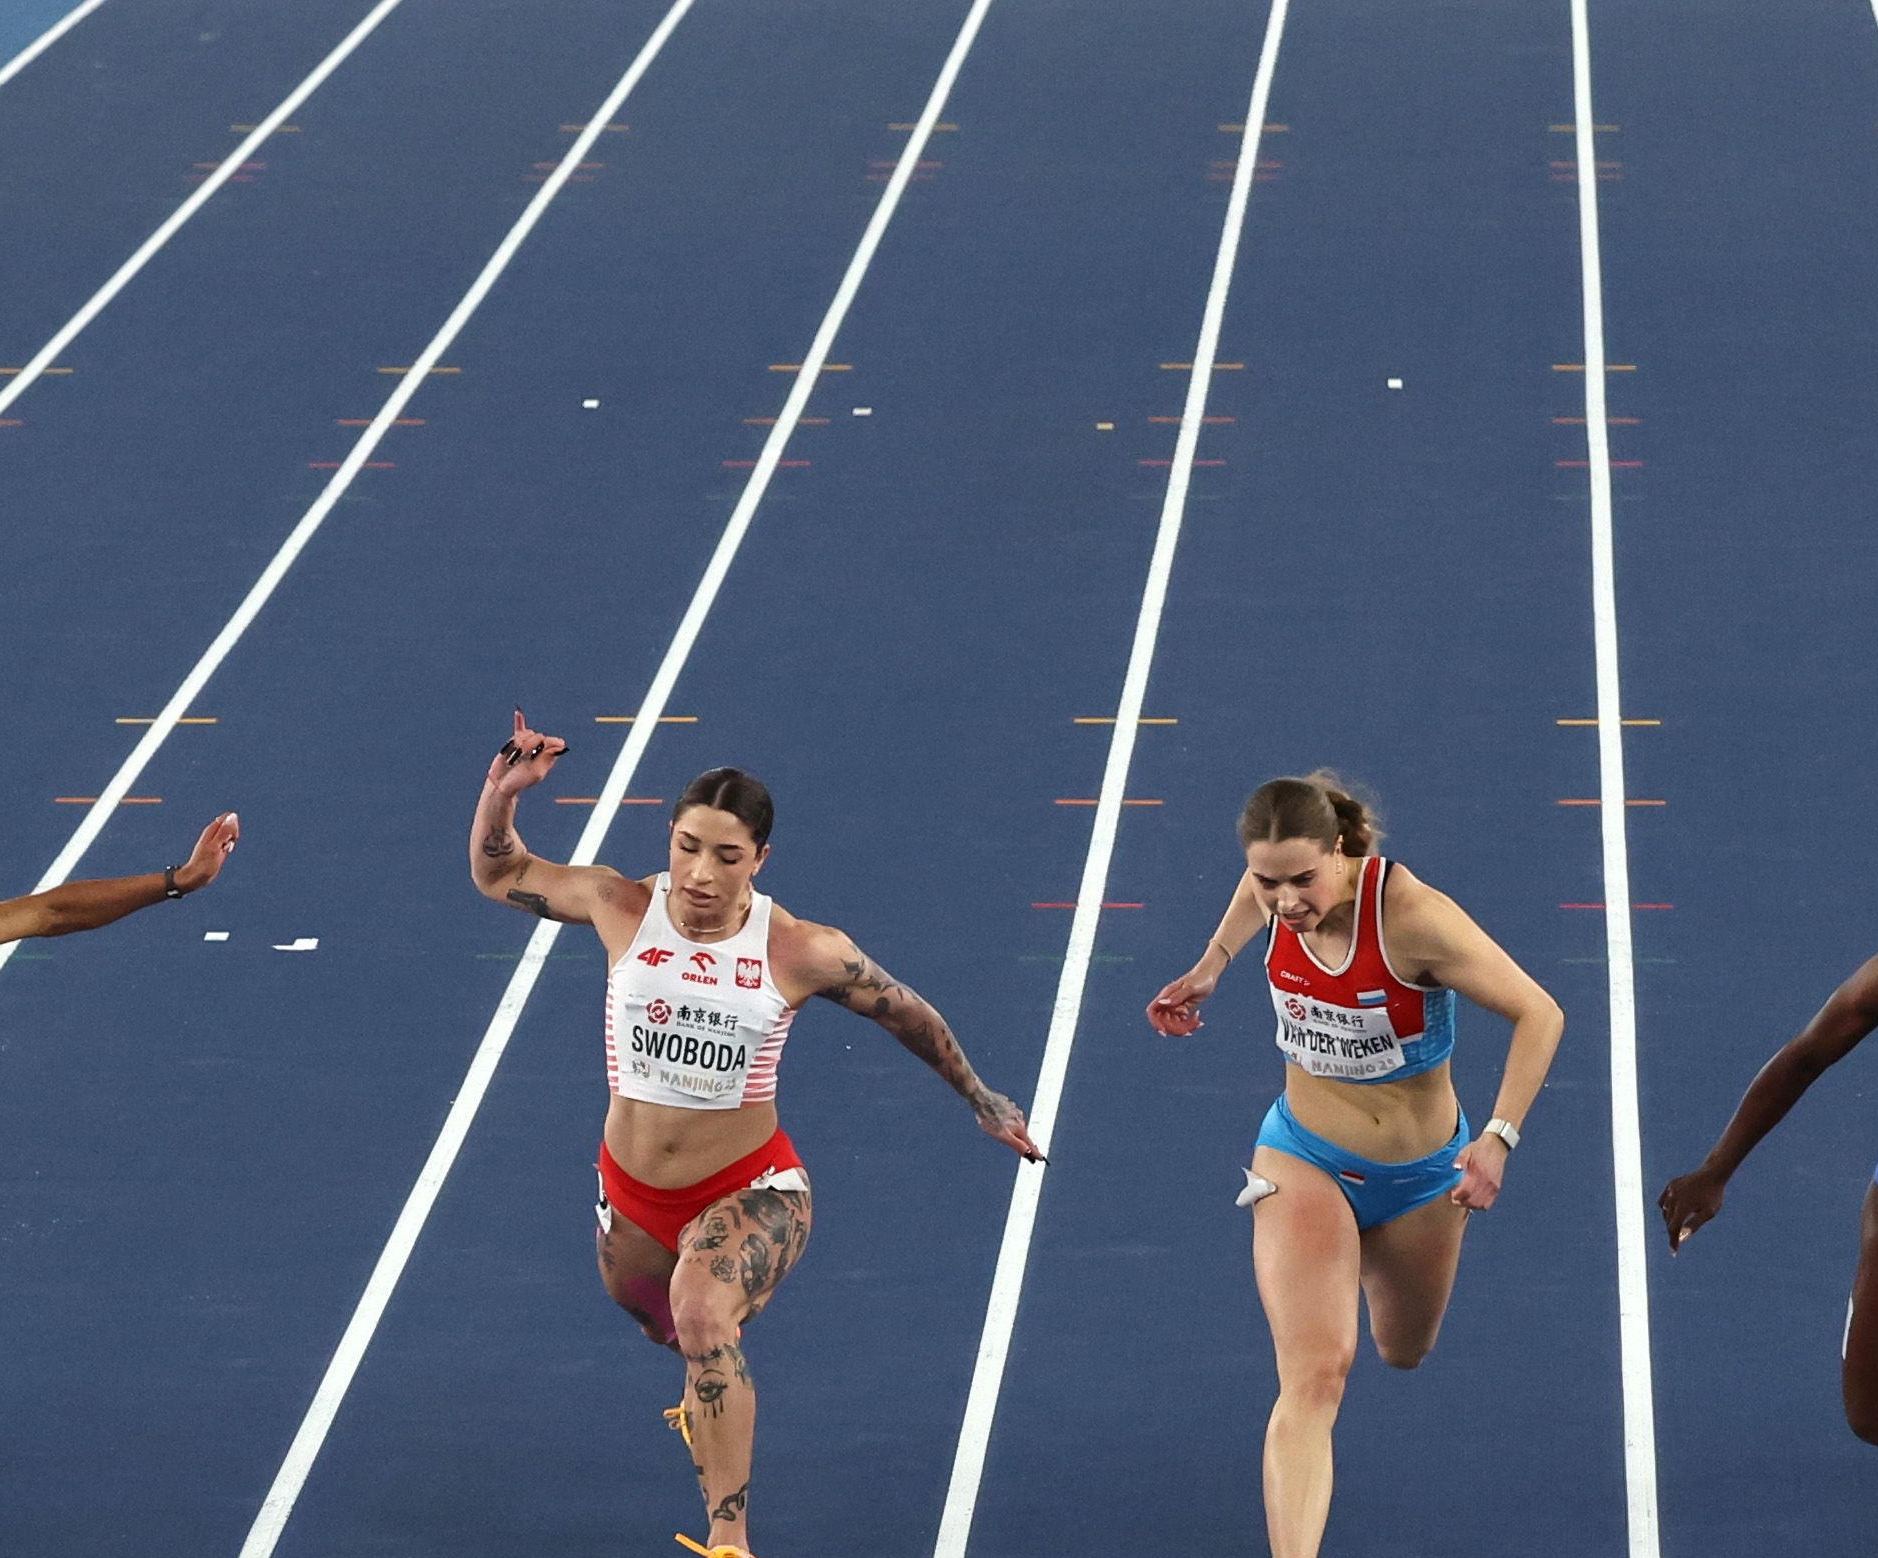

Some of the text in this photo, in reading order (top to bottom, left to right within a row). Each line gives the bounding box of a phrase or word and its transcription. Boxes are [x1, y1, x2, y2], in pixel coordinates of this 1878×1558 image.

[637, 947, 675, 967] 4F
[681, 972, 718, 985] ORLEN
[677, 1005, 739, 1031] 南京银行
[631, 1025, 746, 1072] SWOBODA
[1306, 1028, 1337, 1056] DER
[660, 1070, 722, 1093] NANJING
